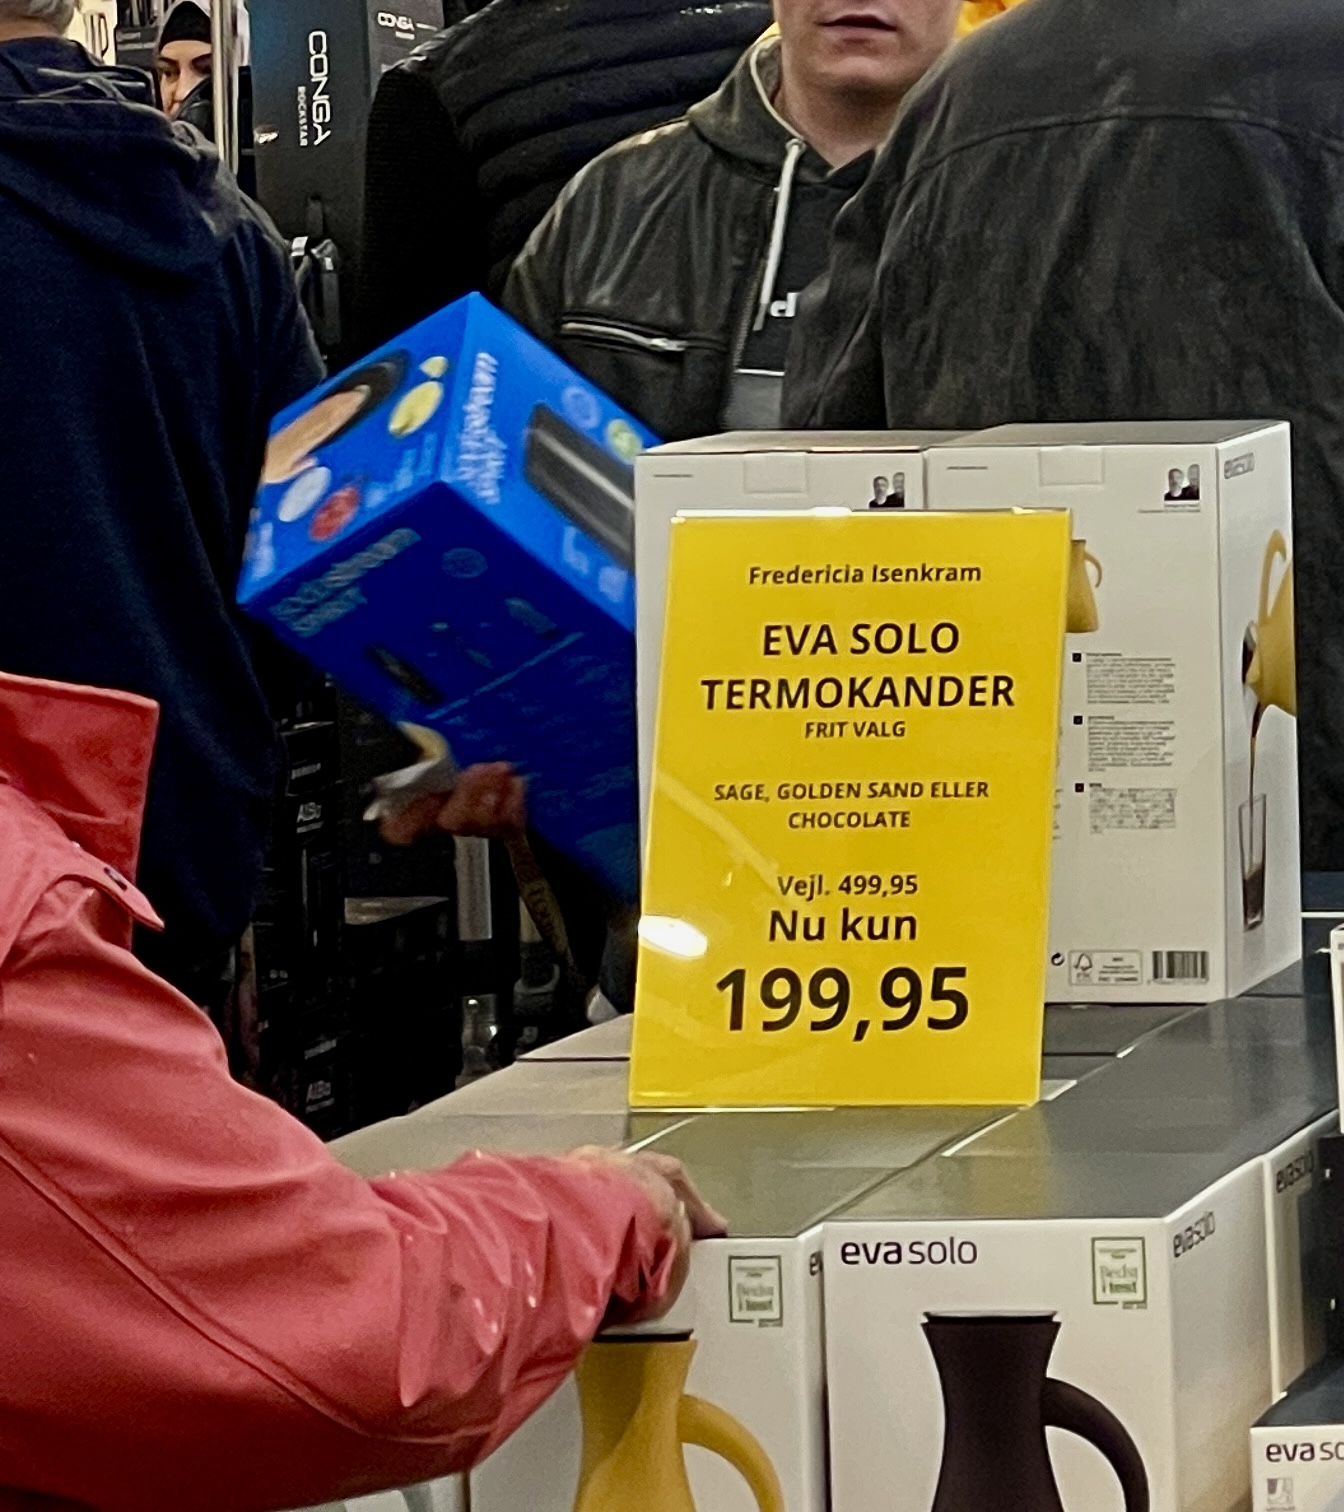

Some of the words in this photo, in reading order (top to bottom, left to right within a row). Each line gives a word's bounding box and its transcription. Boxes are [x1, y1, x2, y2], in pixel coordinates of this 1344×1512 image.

[309, 31, 331, 146] CONGA
[750, 565, 863, 584] Fredericia
[872, 563, 981, 582] Isenkram
[764, 624, 837, 655] EVA
[851, 623, 959, 654] SOLO
[701, 676, 1014, 710] TERMOKANDER
[806, 722, 848, 738] FRIT
[853, 721, 905, 737] VALG
[715, 784, 769, 802] SAGE,
[778, 783, 861, 800] GOLDEN
[867, 782, 923, 798] SAND
[931, 782, 988, 797] ELLER
[789, 811, 910, 828] CHOCOLATE
[778, 875, 830, 898] Vejl.
[839, 875, 917, 897] 499,95
[770, 910, 825, 941] Nu
[842, 907, 916, 940] kun
[717, 967, 968, 1041] 199,95
